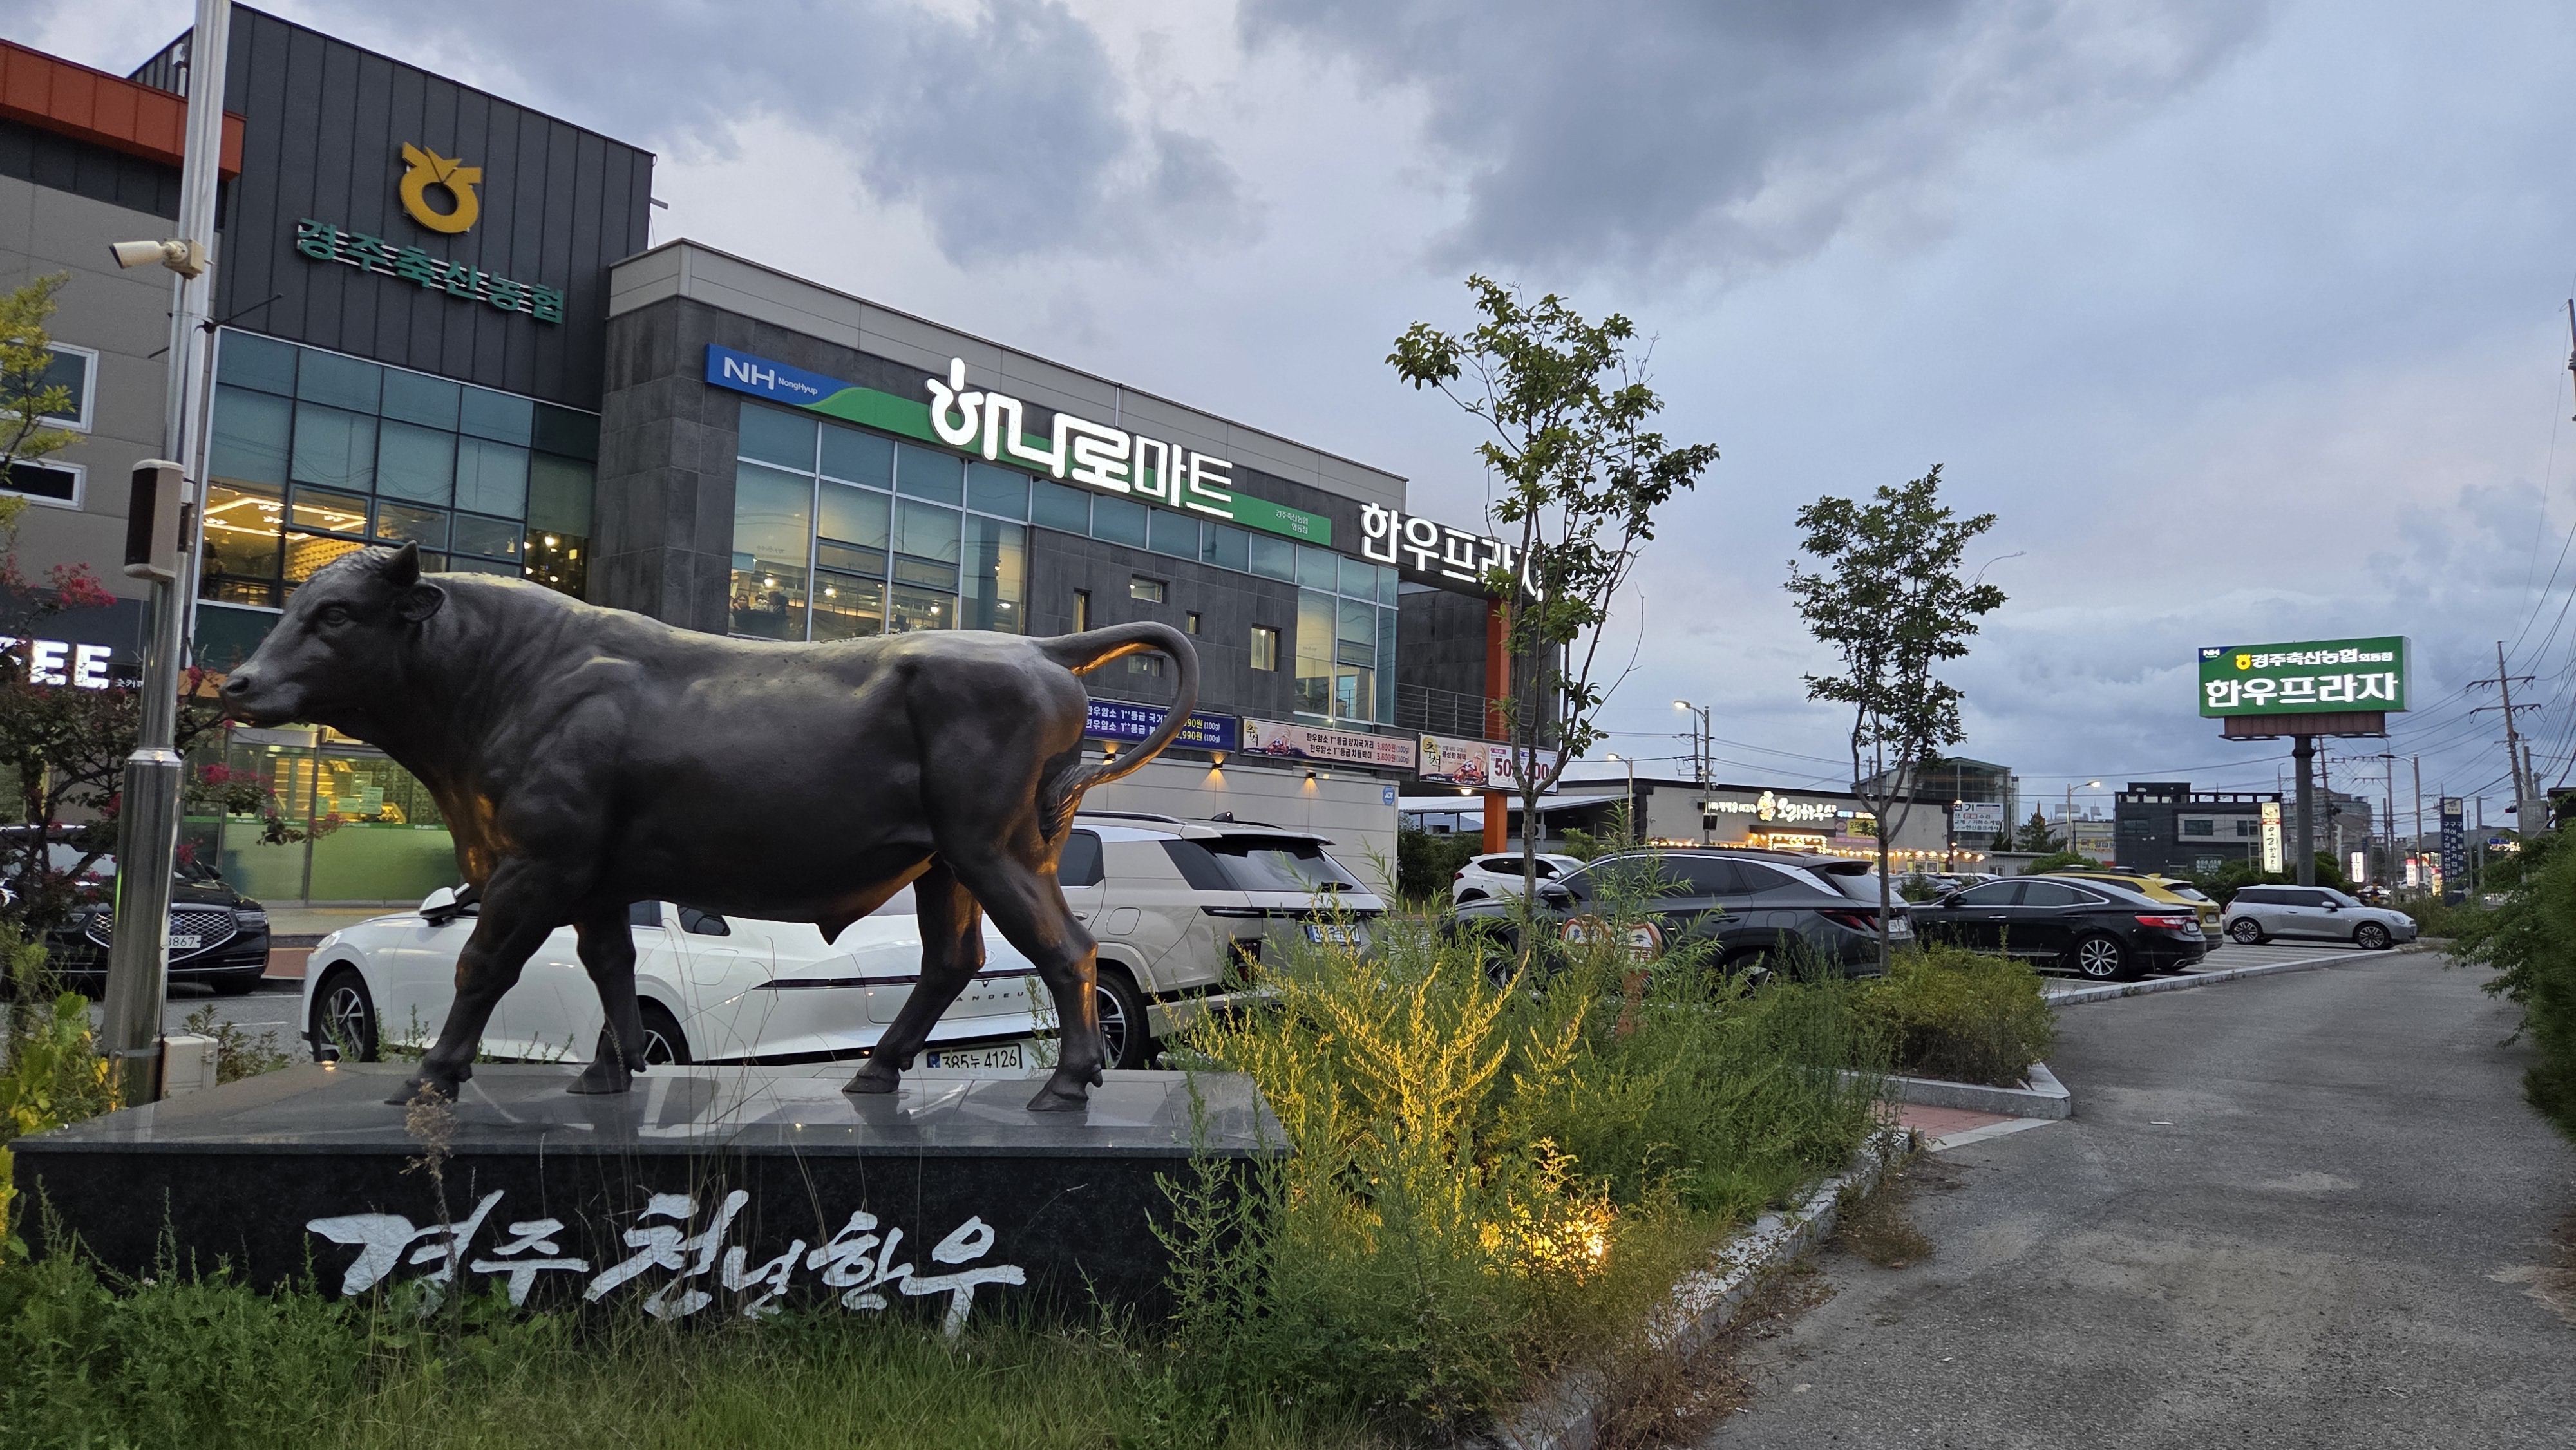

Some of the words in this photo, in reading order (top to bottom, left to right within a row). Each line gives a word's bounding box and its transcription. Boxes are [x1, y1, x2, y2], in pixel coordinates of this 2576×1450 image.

[298, 218, 564, 324] 경주축산농협
[724, 356, 775, 390] NH
[778, 377, 818, 396] NongHyup
[925, 357, 1234, 520] 하나로마트
[0, 636, 112, 690] EE
[2251, 648, 2358, 668] 경주축산농협
[2358, 652, 2393, 663] 외동점
[2205, 672, 2398, 708] 한우프라자
[1086, 719, 1117, 731] 한우암소
[1204, 733, 1220, 744] (100g)
[1149, 713, 1168, 723] 국거
[1204, 721, 1220, 731] (100g)
[1307, 733, 1328, 743] 한우암소
[1310, 744, 1332, 755] 한우암소
[1425, 741, 1441, 773] 추석
[955, 992, 1024, 1003] ANDEU
[984, 1049, 1017, 1069] 4126
